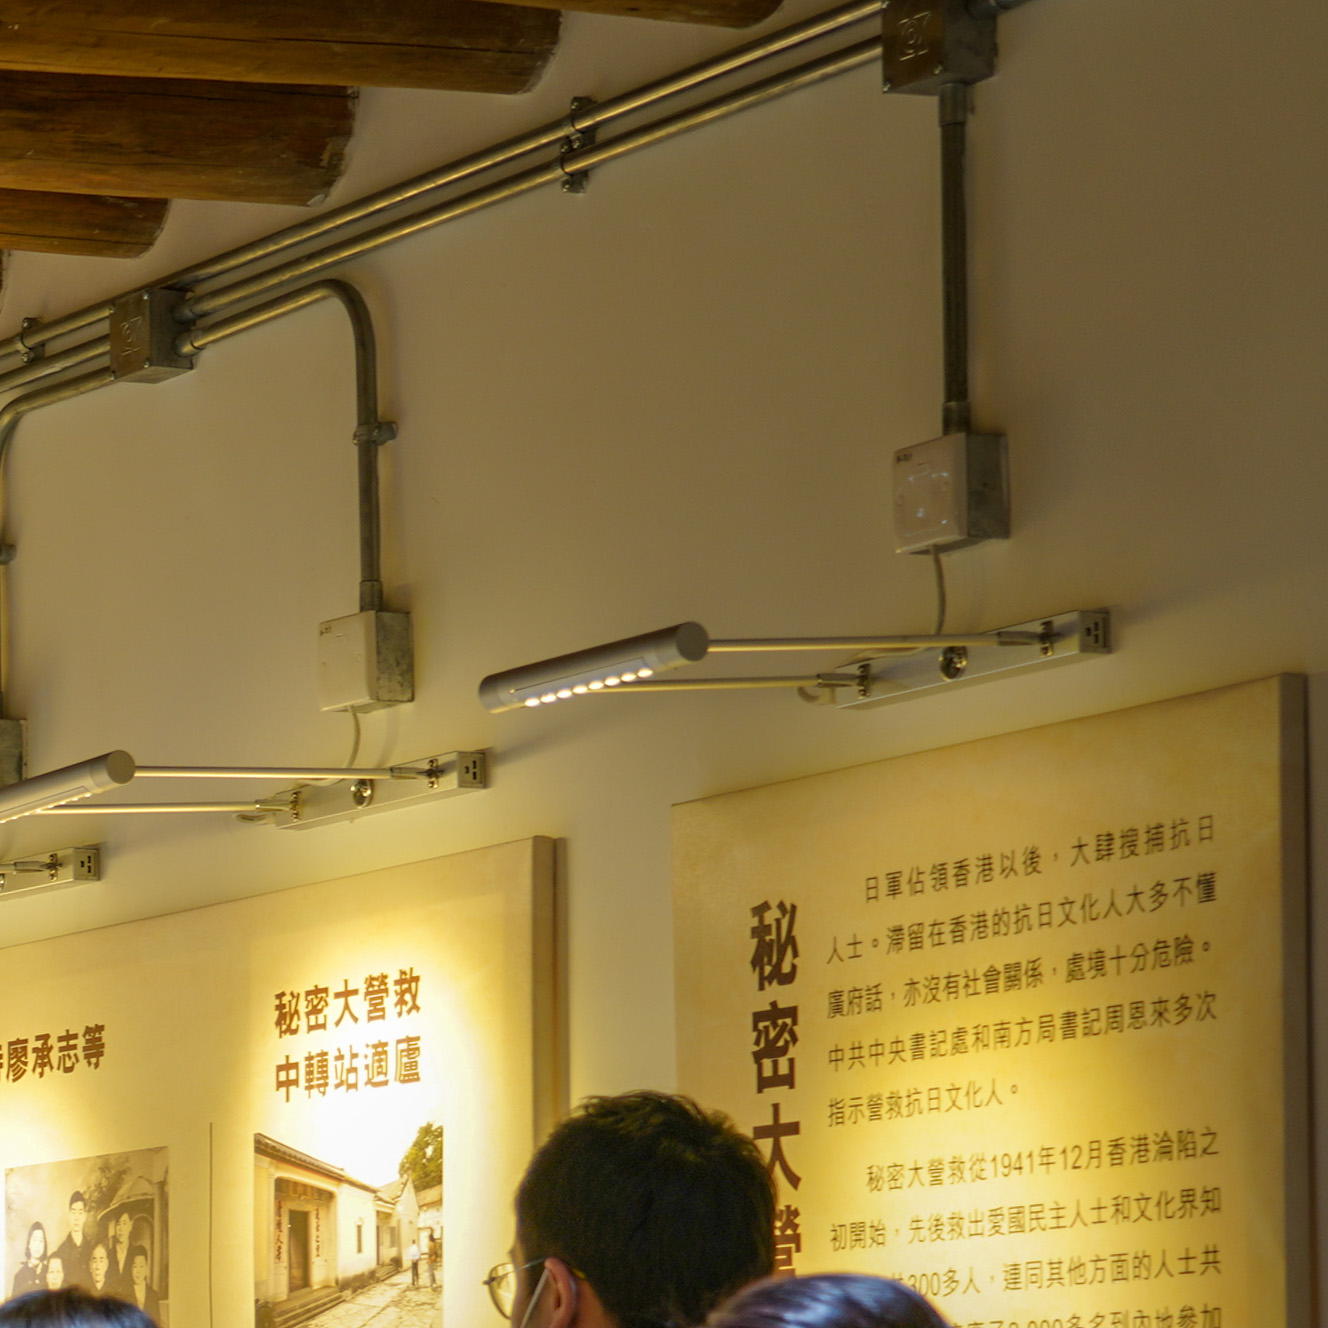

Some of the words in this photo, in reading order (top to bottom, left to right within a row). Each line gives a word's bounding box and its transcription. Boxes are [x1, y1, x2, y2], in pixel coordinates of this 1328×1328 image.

[865, 815, 1215, 904] 日軍佔領香港以後，大肆搜捕抗日
[826, 872, 1217, 965] 人士。滯留在香港的抗日文化人大多不懂
[274, 967, 421, 1039] 秘密大營救
[827, 933, 1211, 1019] 廣府話，亦沒有社會關係，處境十分危險。
[828, 990, 1217, 1072] 中共中央書記處和南方局書記周恩來多次
[275, 1035, 421, 1103] 中轉站適廬
[828, 1078, 1019, 1128] 指示營救抗日文化人。
[866, 1126, 1220, 1193] 秘密大營救從1941年12月香港淪陷之
[830, 1187, 1221, 1252] 初開始，先後救出愛國民主人士和文化界知
